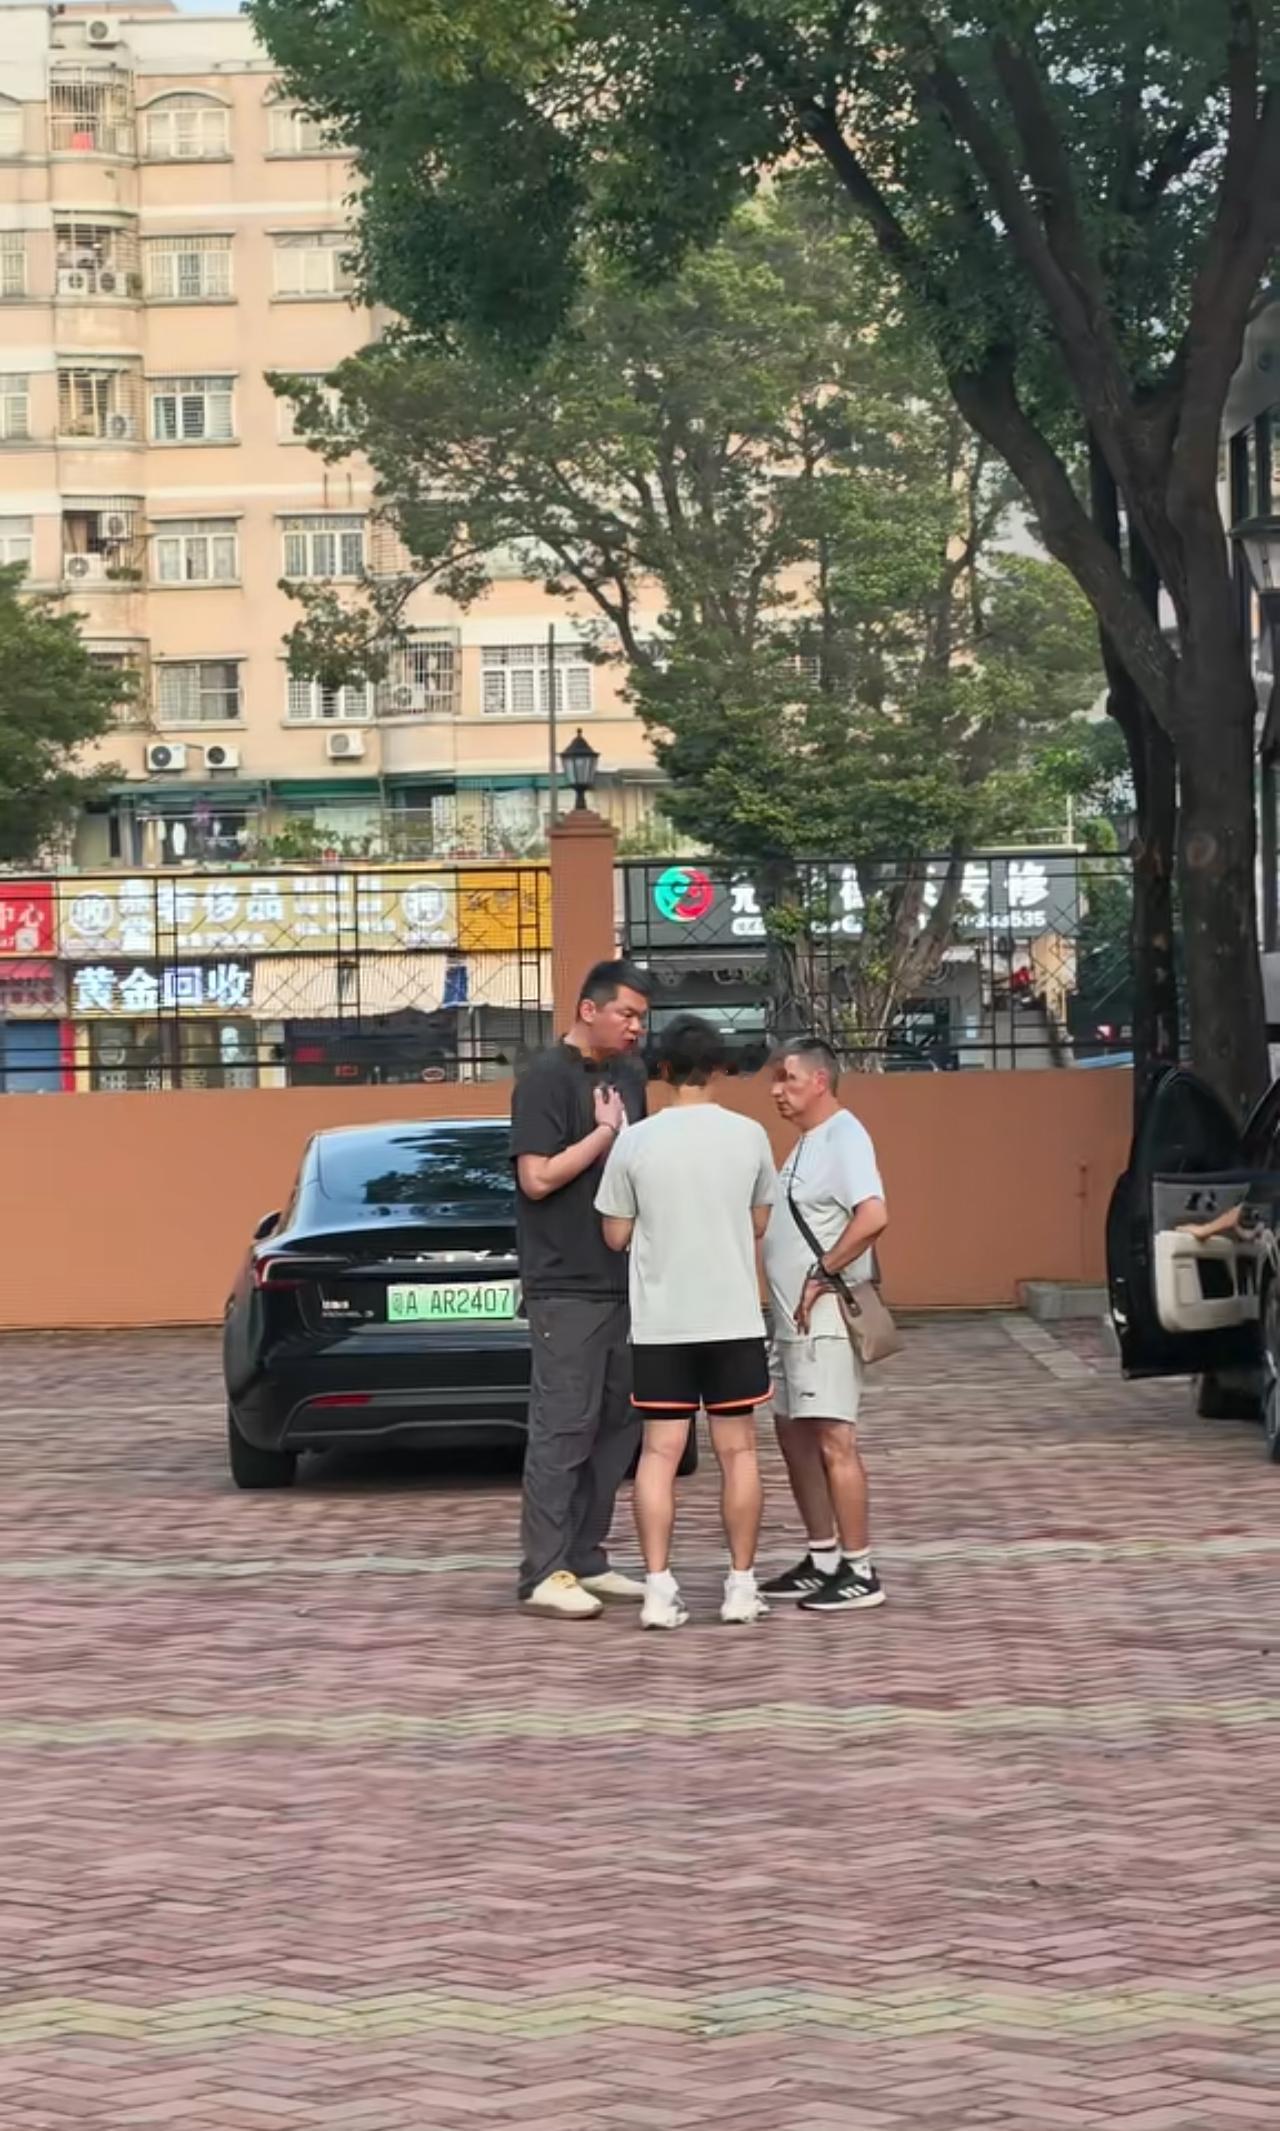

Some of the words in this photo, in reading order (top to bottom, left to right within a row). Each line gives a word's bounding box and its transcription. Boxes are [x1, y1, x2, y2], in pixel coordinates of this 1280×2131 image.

[74, 964, 252, 1011] 黄金回收
[430, 1287, 510, 1315] AR2407
